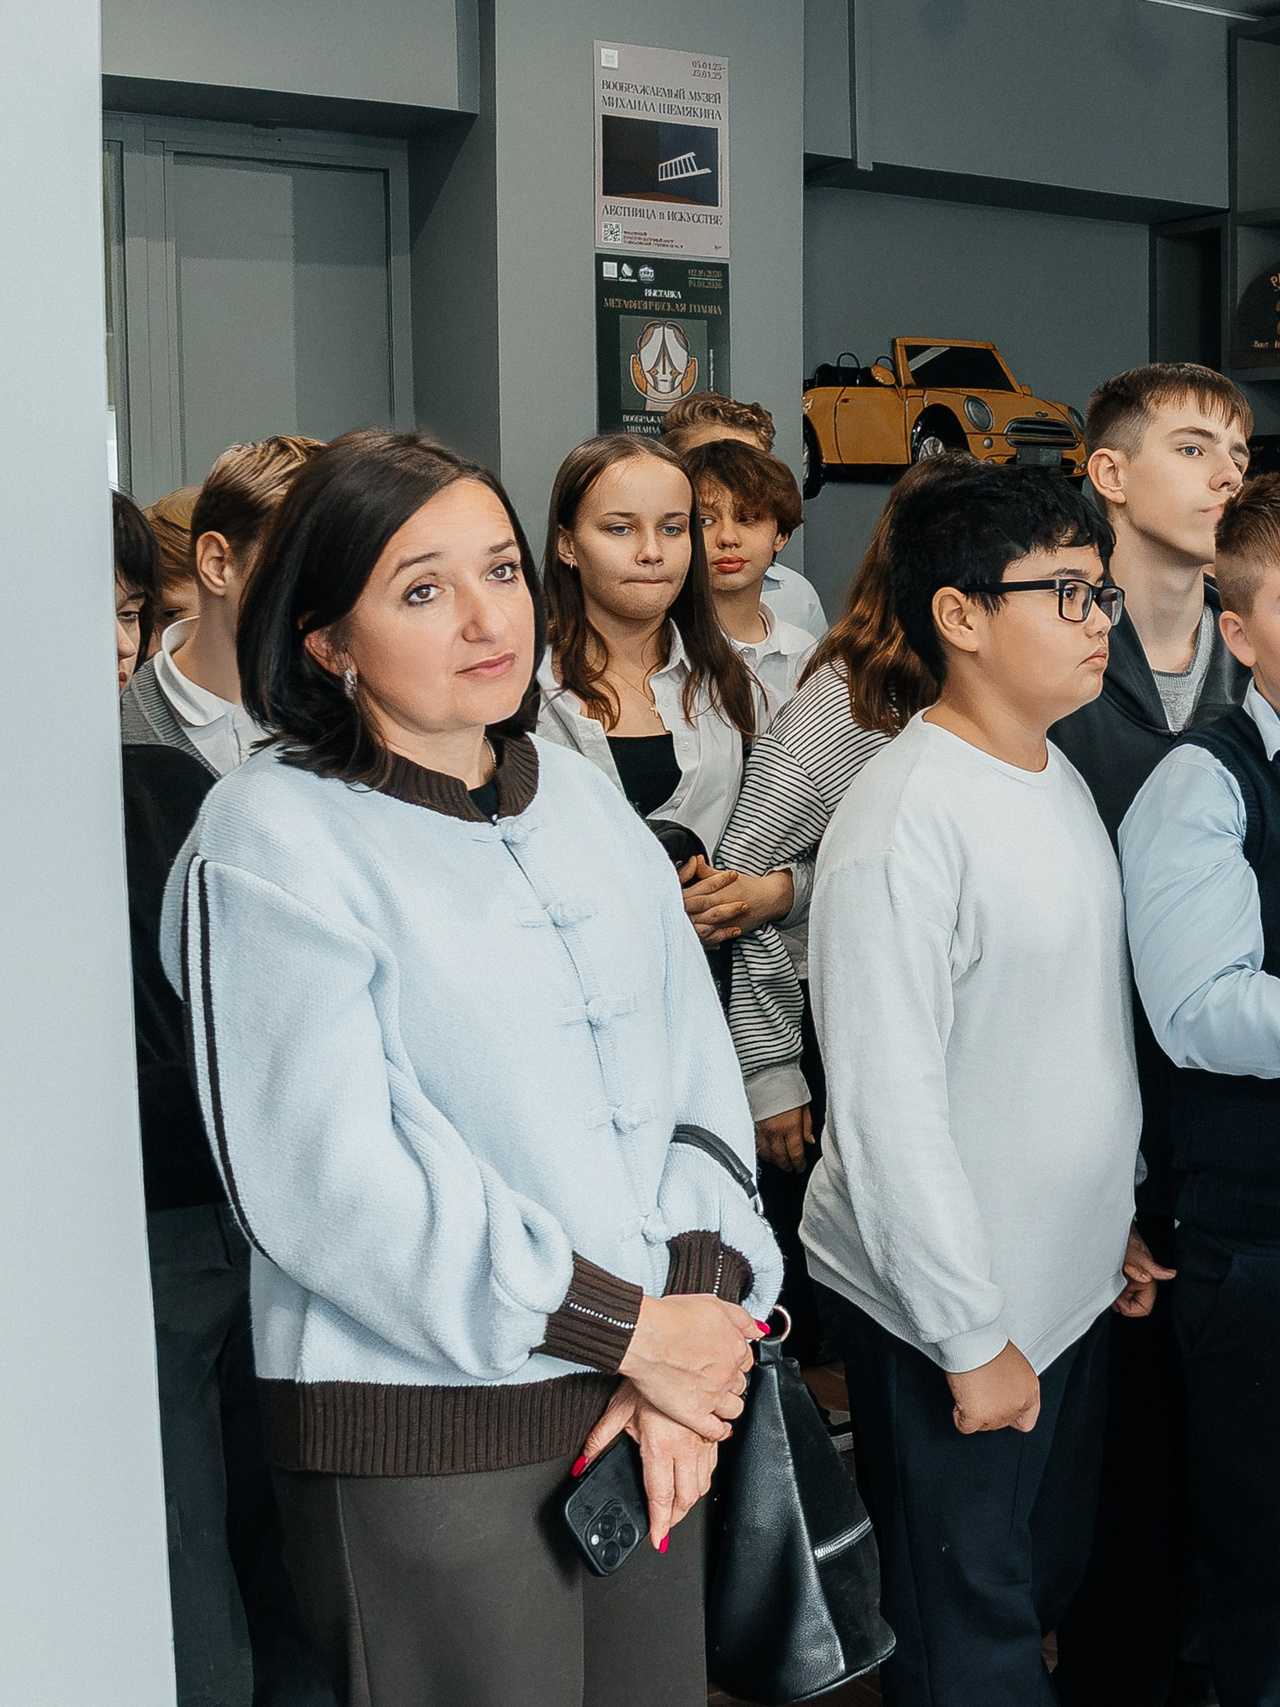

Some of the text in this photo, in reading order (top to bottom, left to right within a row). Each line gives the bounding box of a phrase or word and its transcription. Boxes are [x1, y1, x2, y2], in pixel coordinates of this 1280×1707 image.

[601, 79, 722, 104] ВООБРАЖАЕМЫЙ МУЗЕЙ
[601, 95, 722, 121] МИХАИЛА ШЕМЯКИНА
[602, 204, 657, 221] ЛЕСТНИЦА
[667, 211, 723, 226] ИСКУССТВЕ
